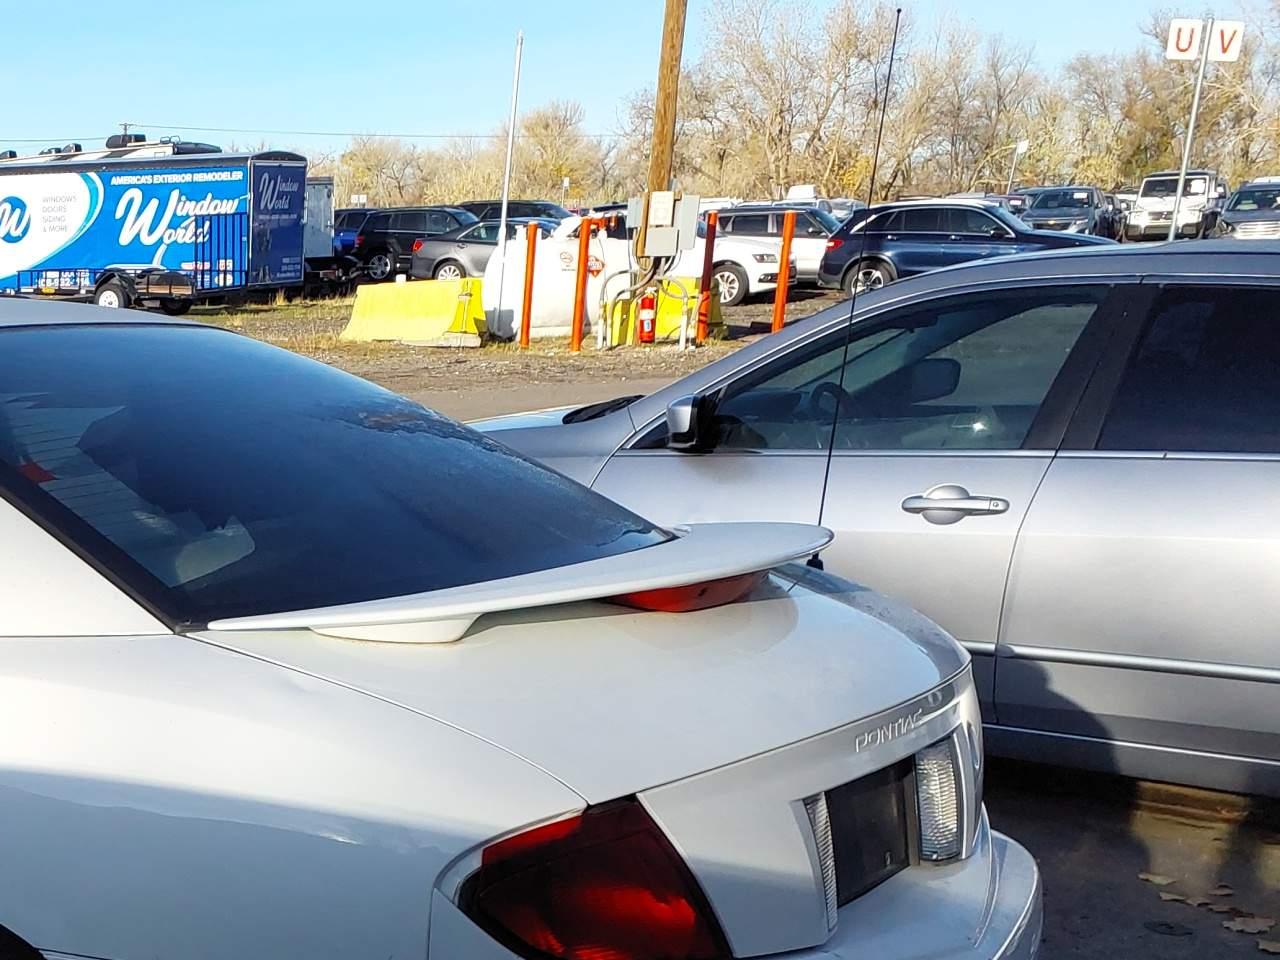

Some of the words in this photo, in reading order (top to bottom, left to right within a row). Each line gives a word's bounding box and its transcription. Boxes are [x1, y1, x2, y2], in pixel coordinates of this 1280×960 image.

[1176, 27, 1195, 52] U
[1220, 29, 1237, 53] V
[111, 175, 153, 185] AMERICA'S
[153, 173, 193, 184] EXTERIOR
[193, 171, 243, 182] REMODELER
[855, 708, 922, 753] PONTIAC
